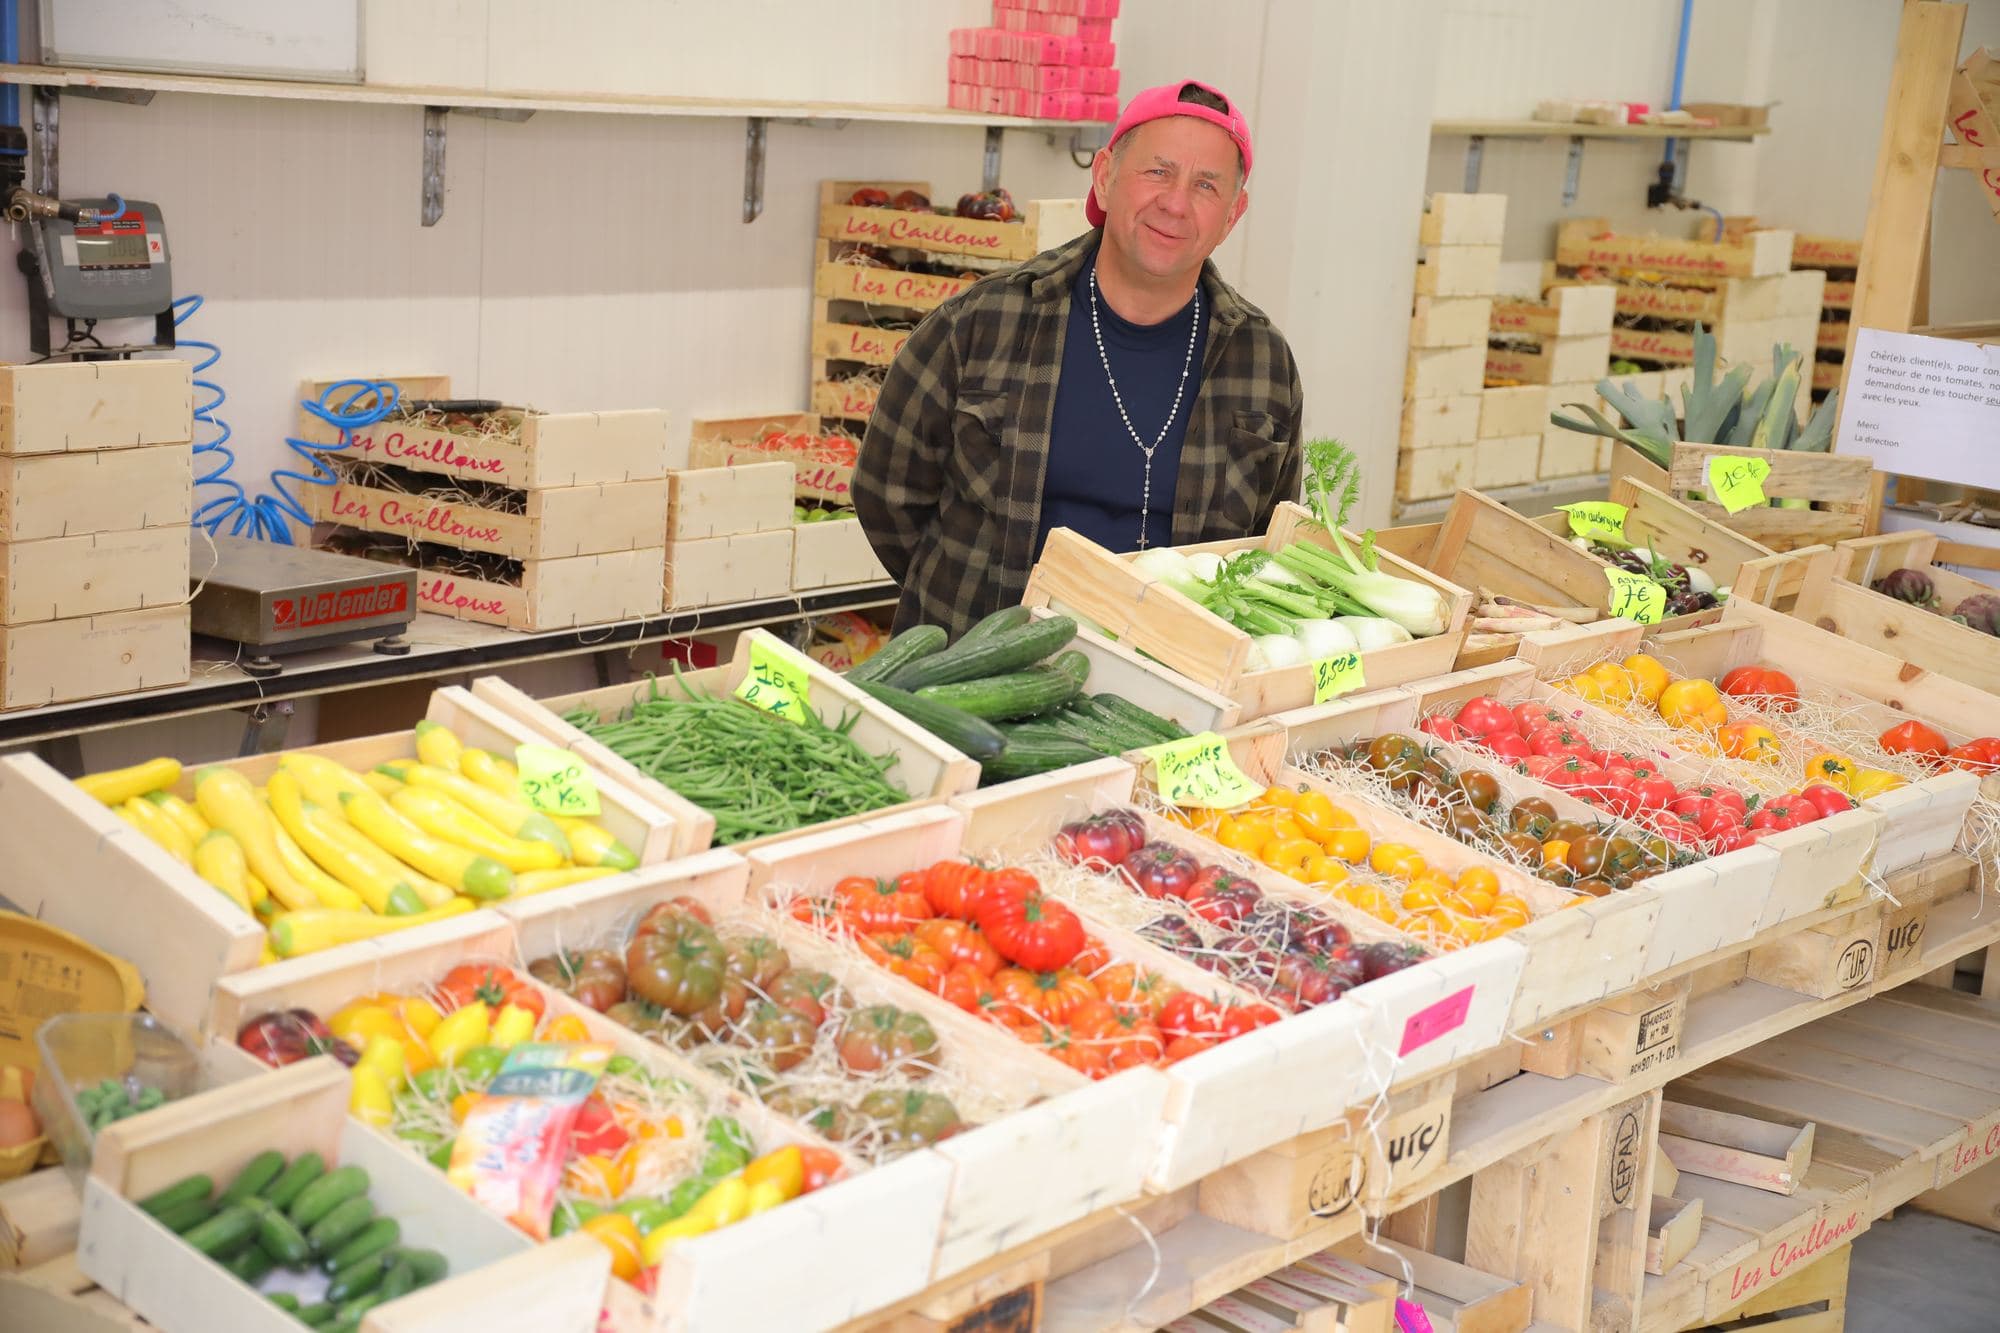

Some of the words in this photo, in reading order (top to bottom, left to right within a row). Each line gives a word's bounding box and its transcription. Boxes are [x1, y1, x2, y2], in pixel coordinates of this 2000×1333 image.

[846, 216, 881, 235] Les
[888, 217, 1001, 249] Cailloux
[895, 277, 961, 301] Caill
[851, 331, 886, 356] Les
[1910, 370, 1922, 380] de
[1925, 374, 1942, 383] nos
[1945, 375, 1985, 390] tomates,
[1989, 383, 2000, 392] no
[1957, 363, 1980, 375] pour
[1982, 367, 2000, 377] con
[1862, 393, 1883, 403] avec
[1884, 394, 1896, 404] les
[1898, 398, 1921, 409] yeux.
[1864, 378, 1916, 394] demandons
[1918, 385, 1931, 395] de
[1933, 387, 1946, 398] les
[1948, 389, 1984, 403] toucher
[1986, 396, 2000, 406] seu
[1856, 420, 1880, 431] Merci
[384, 432, 505, 474] Cailloux
[1854, 433, 1863, 442] La
[1864, 435, 1900, 449] direction
[331, 490, 371, 519] Les
[379, 500, 503, 543] Cailloux
[302, 585, 401, 623] Defender
[417, 579, 507, 616] illoux
[1615, 1122, 1636, 1192] EPAL
[1730, 1263, 1764, 1301] Les
[1769, 1211, 1858, 1278] Cailloux
